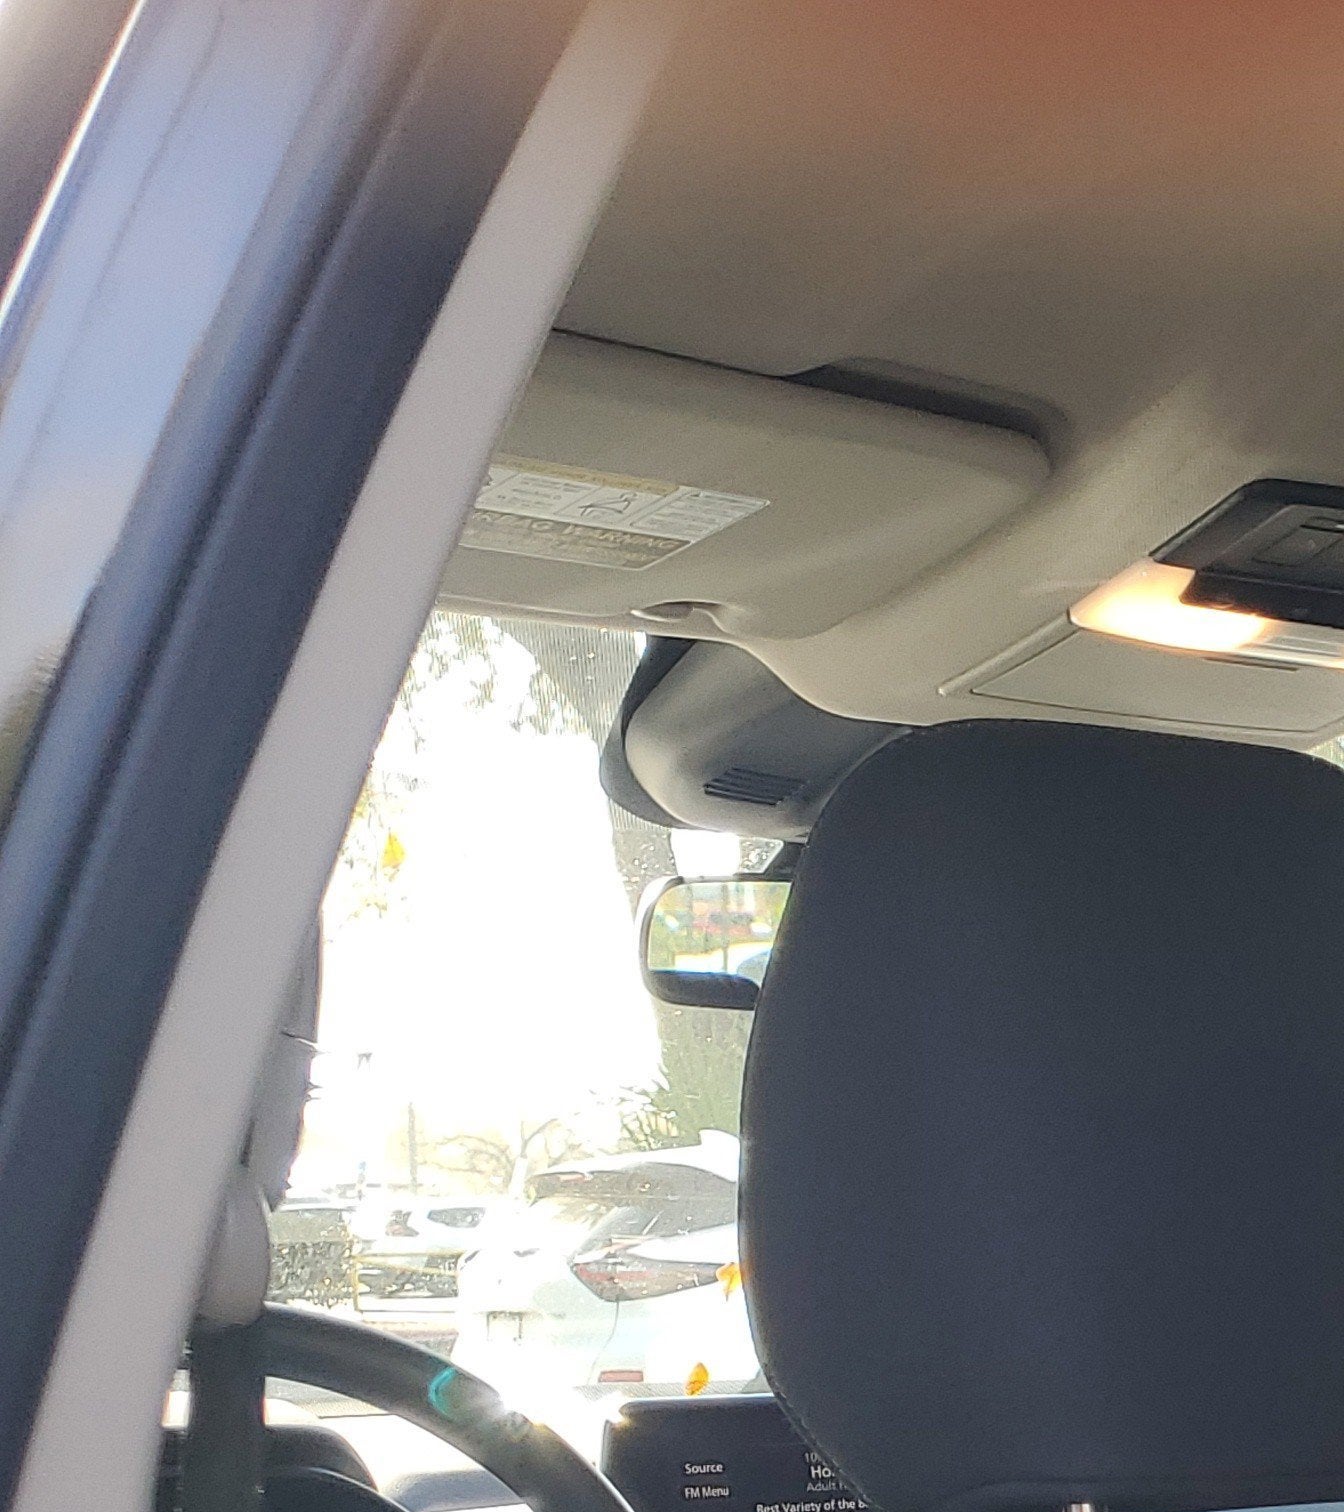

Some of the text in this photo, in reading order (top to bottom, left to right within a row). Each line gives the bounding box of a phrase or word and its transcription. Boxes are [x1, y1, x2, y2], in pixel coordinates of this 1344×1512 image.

[685, 1463, 723, 1474] Source
[810, 1465, 835, 1479] Ho
[684, 1486, 730, 1498] FM Menu
[823, 1499, 836, 1511] of
[838, 1498, 856, 1509] the
